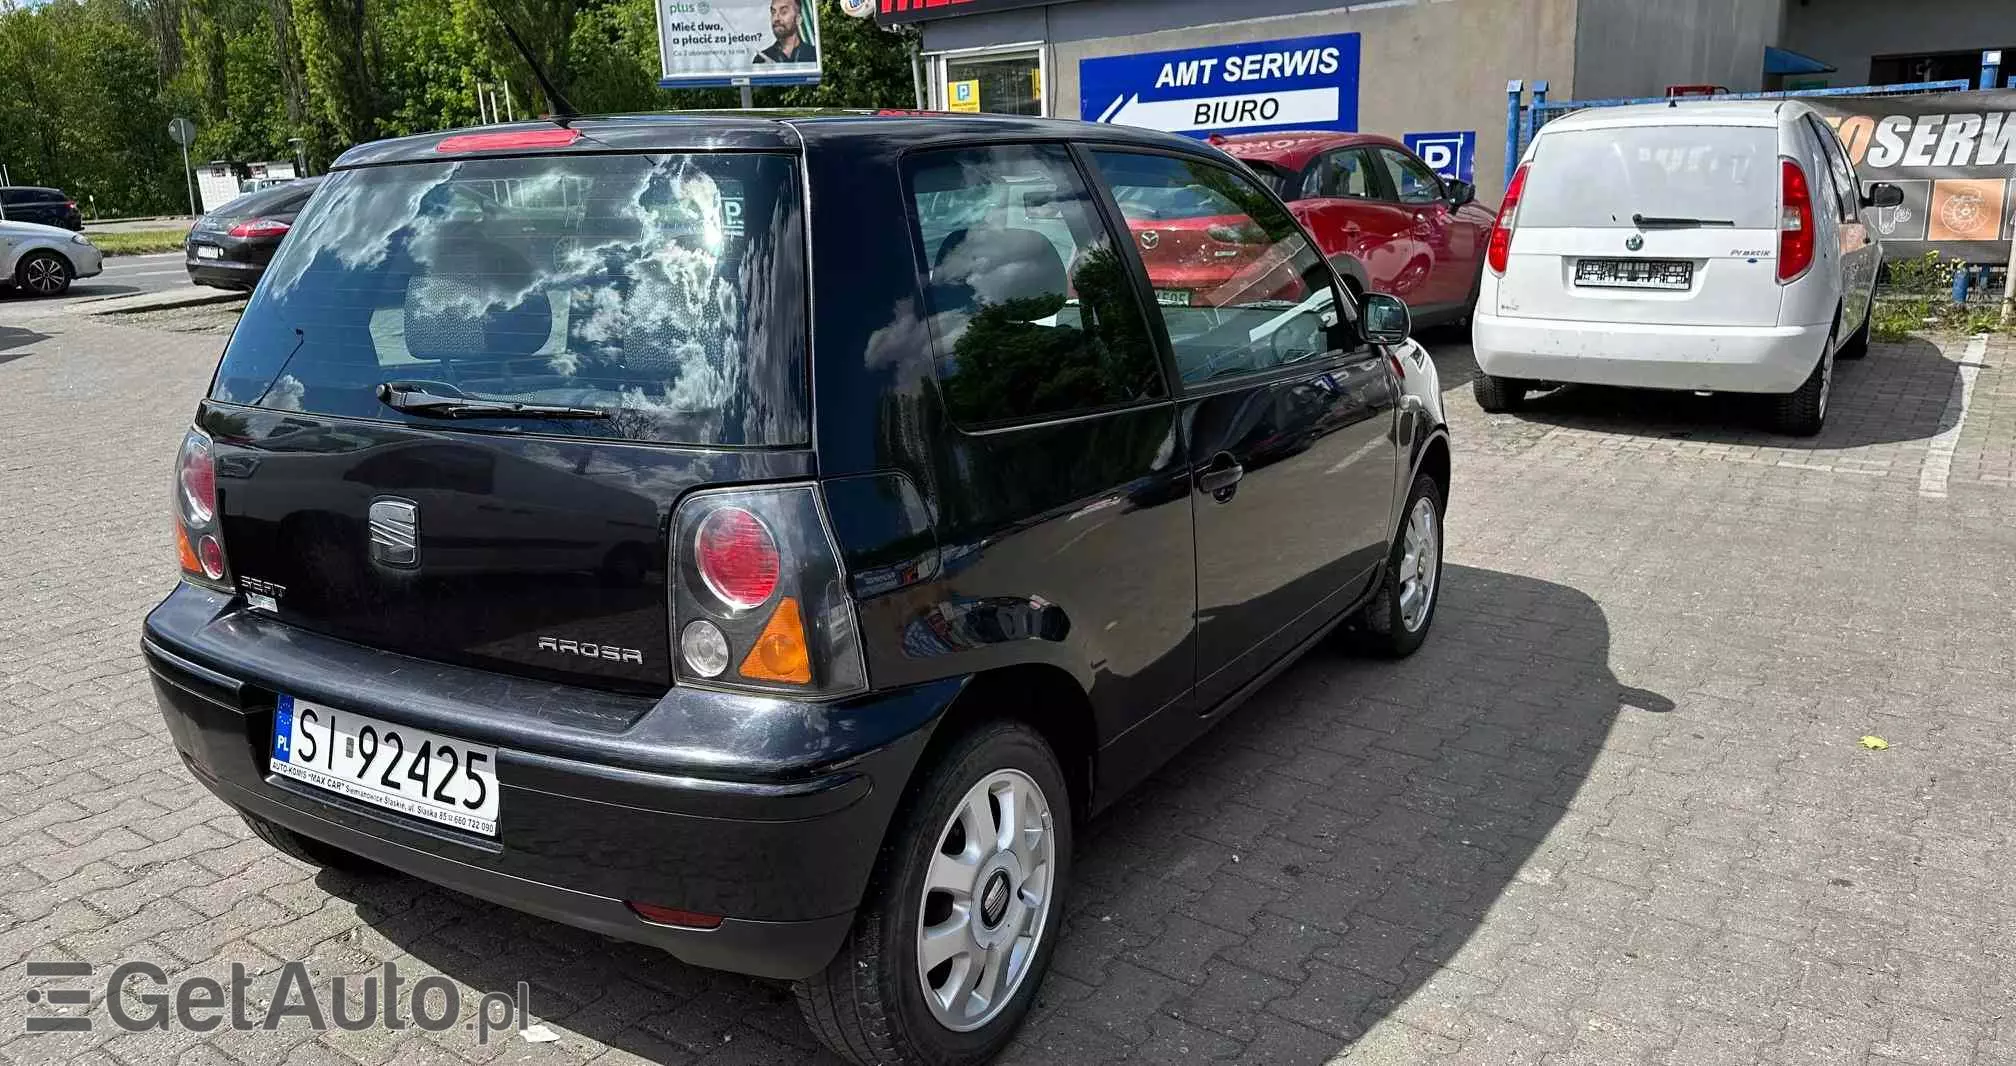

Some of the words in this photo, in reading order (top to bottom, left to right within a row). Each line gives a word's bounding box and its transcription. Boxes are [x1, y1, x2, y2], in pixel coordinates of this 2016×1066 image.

[669, 3, 695, 16] plus
[671, 22, 696, 32] Mieć
[697, 21, 724, 32] dwa,
[672, 37, 680, 45] a
[682, 34, 712, 47] płacić
[714, 35, 726, 44] za
[727, 32, 762, 45] jeden?
[1154, 58, 1218, 89] AMT
[1222, 47, 1340, 82] SERWIS
[1193, 97, 1280, 126] BIURO
[240, 575, 287, 600] SEAT
[538, 636, 643, 665] AROSA
[277, 734, 289, 752] PL
[298, 708, 336, 770] SI
[356, 724, 488, 810] 92425
[272, 761, 307, 780] AUTO-KOMIS
